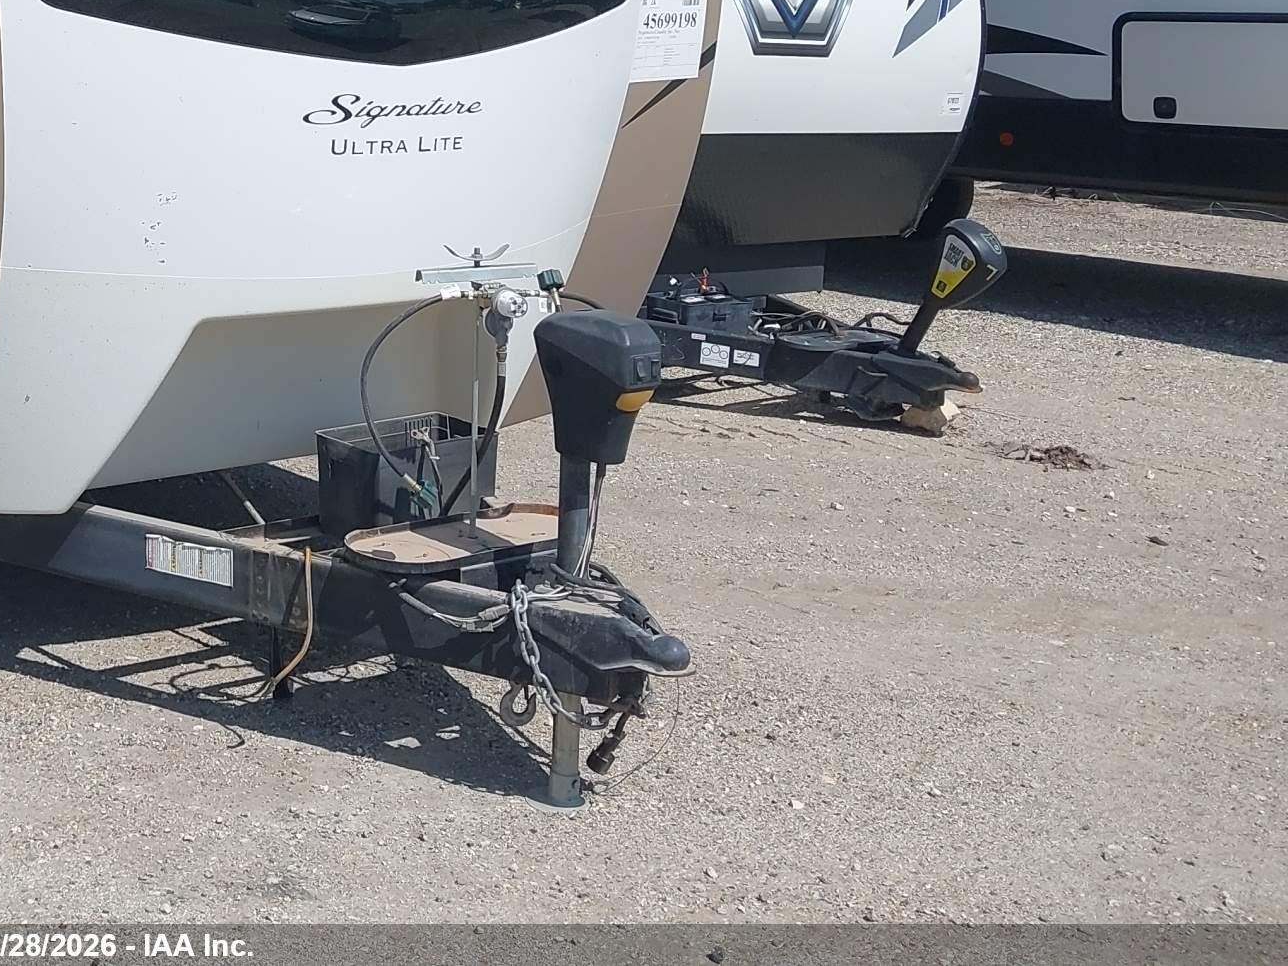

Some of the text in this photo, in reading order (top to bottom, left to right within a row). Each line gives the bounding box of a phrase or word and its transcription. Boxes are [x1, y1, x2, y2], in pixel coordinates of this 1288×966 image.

[642, 11, 698, 29] 45699198
[302, 93, 483, 128] Signature
[330, 136, 463, 155] ULTRA LITE
